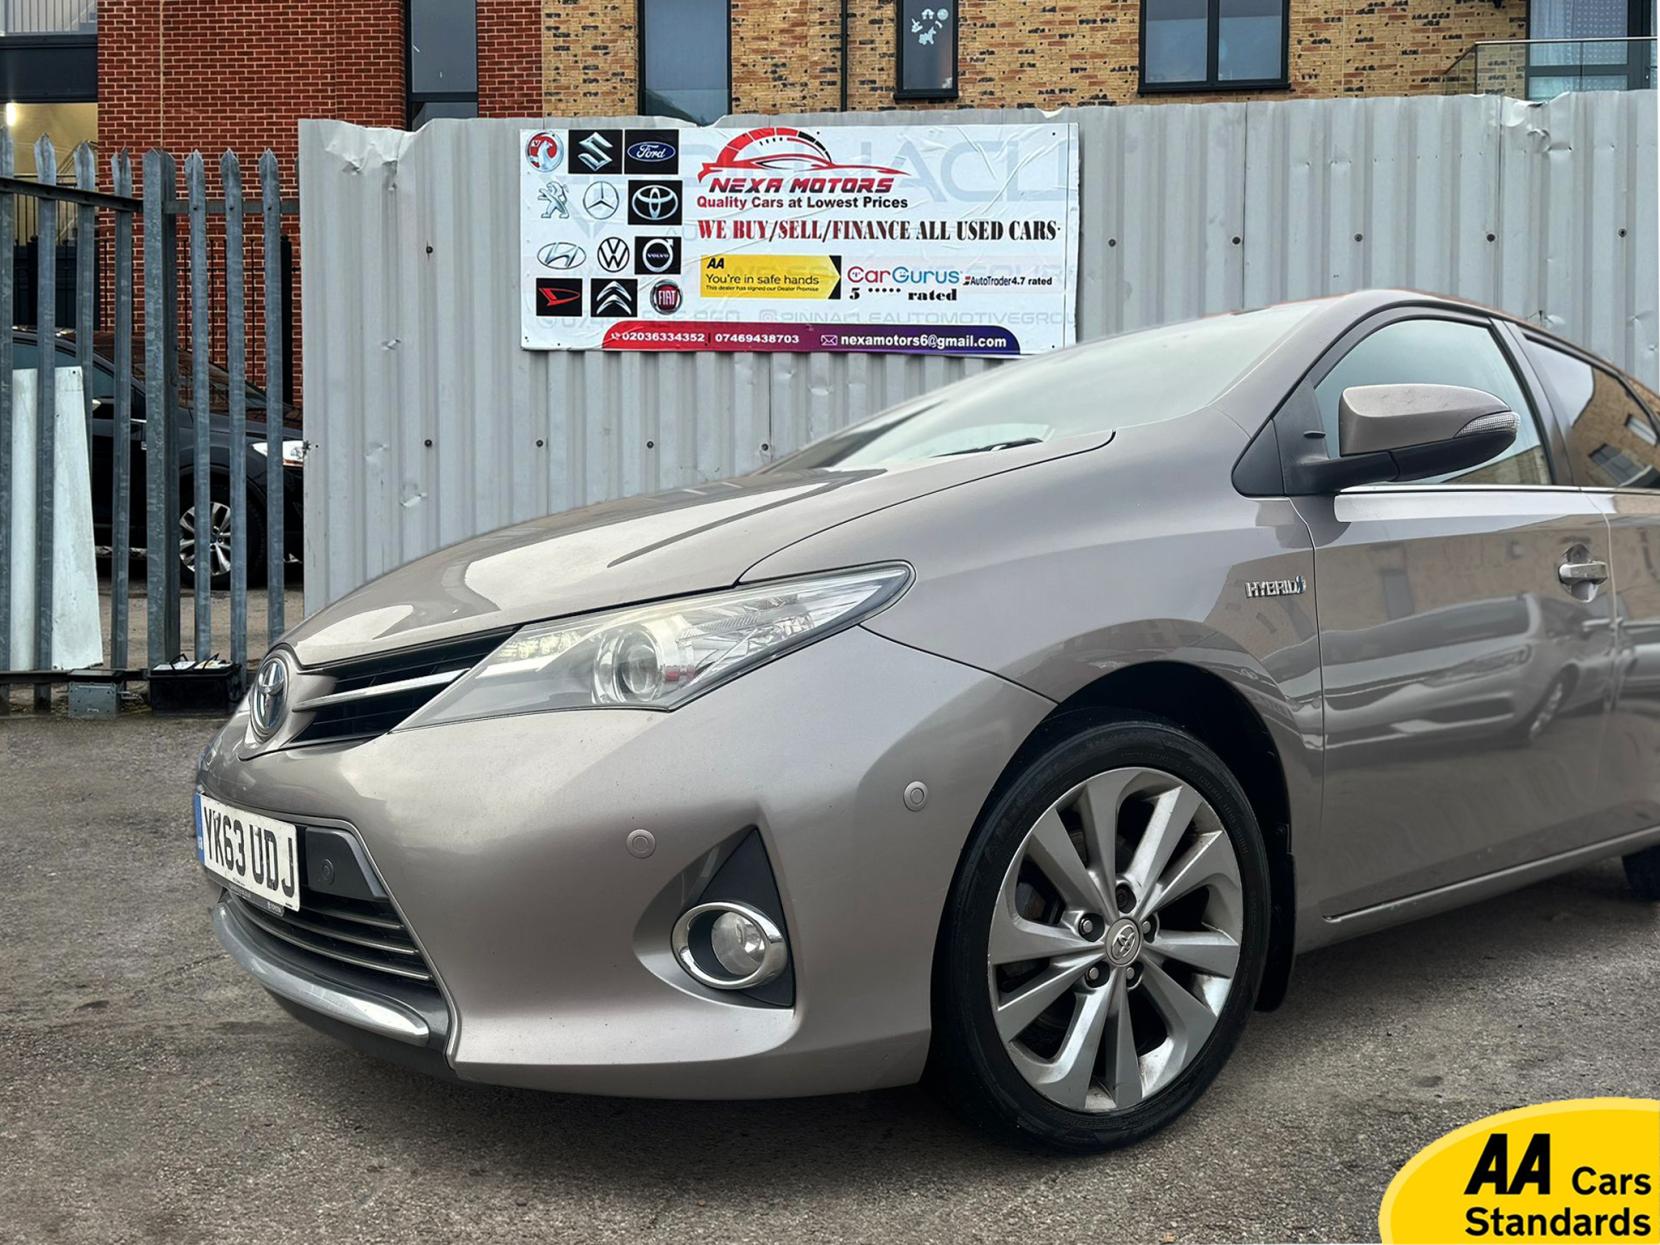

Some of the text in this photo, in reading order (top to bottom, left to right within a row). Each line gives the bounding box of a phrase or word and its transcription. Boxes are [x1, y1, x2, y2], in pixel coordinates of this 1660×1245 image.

[636, 144, 666, 158] Ford
[709, 177, 894, 194] NEXA MOTORS
[697, 195, 908, 210] Quality Cars at Lowest Prices
[697, 220, 727, 240] WE
[915, 220, 951, 240] ALL
[956, 220, 1004, 241] USED
[1008, 221, 1057, 241] CARS
[706, 257, 725, 269] AA
[706, 273, 820, 285] You're in safe hands
[847, 265, 959, 284] CarGurus
[1028, 276, 1053, 286] rated
[658, 289, 676, 306] FIAT
[849, 287, 958, 301] 5 rated
[622, 332, 800, 344] 02036334352 07469438703
[841, 334, 1006, 350] nexamotors6@gmail.com
[1245, 580, 1298, 599] HYBRID
[203, 806, 295, 898] YK63 UDJ
